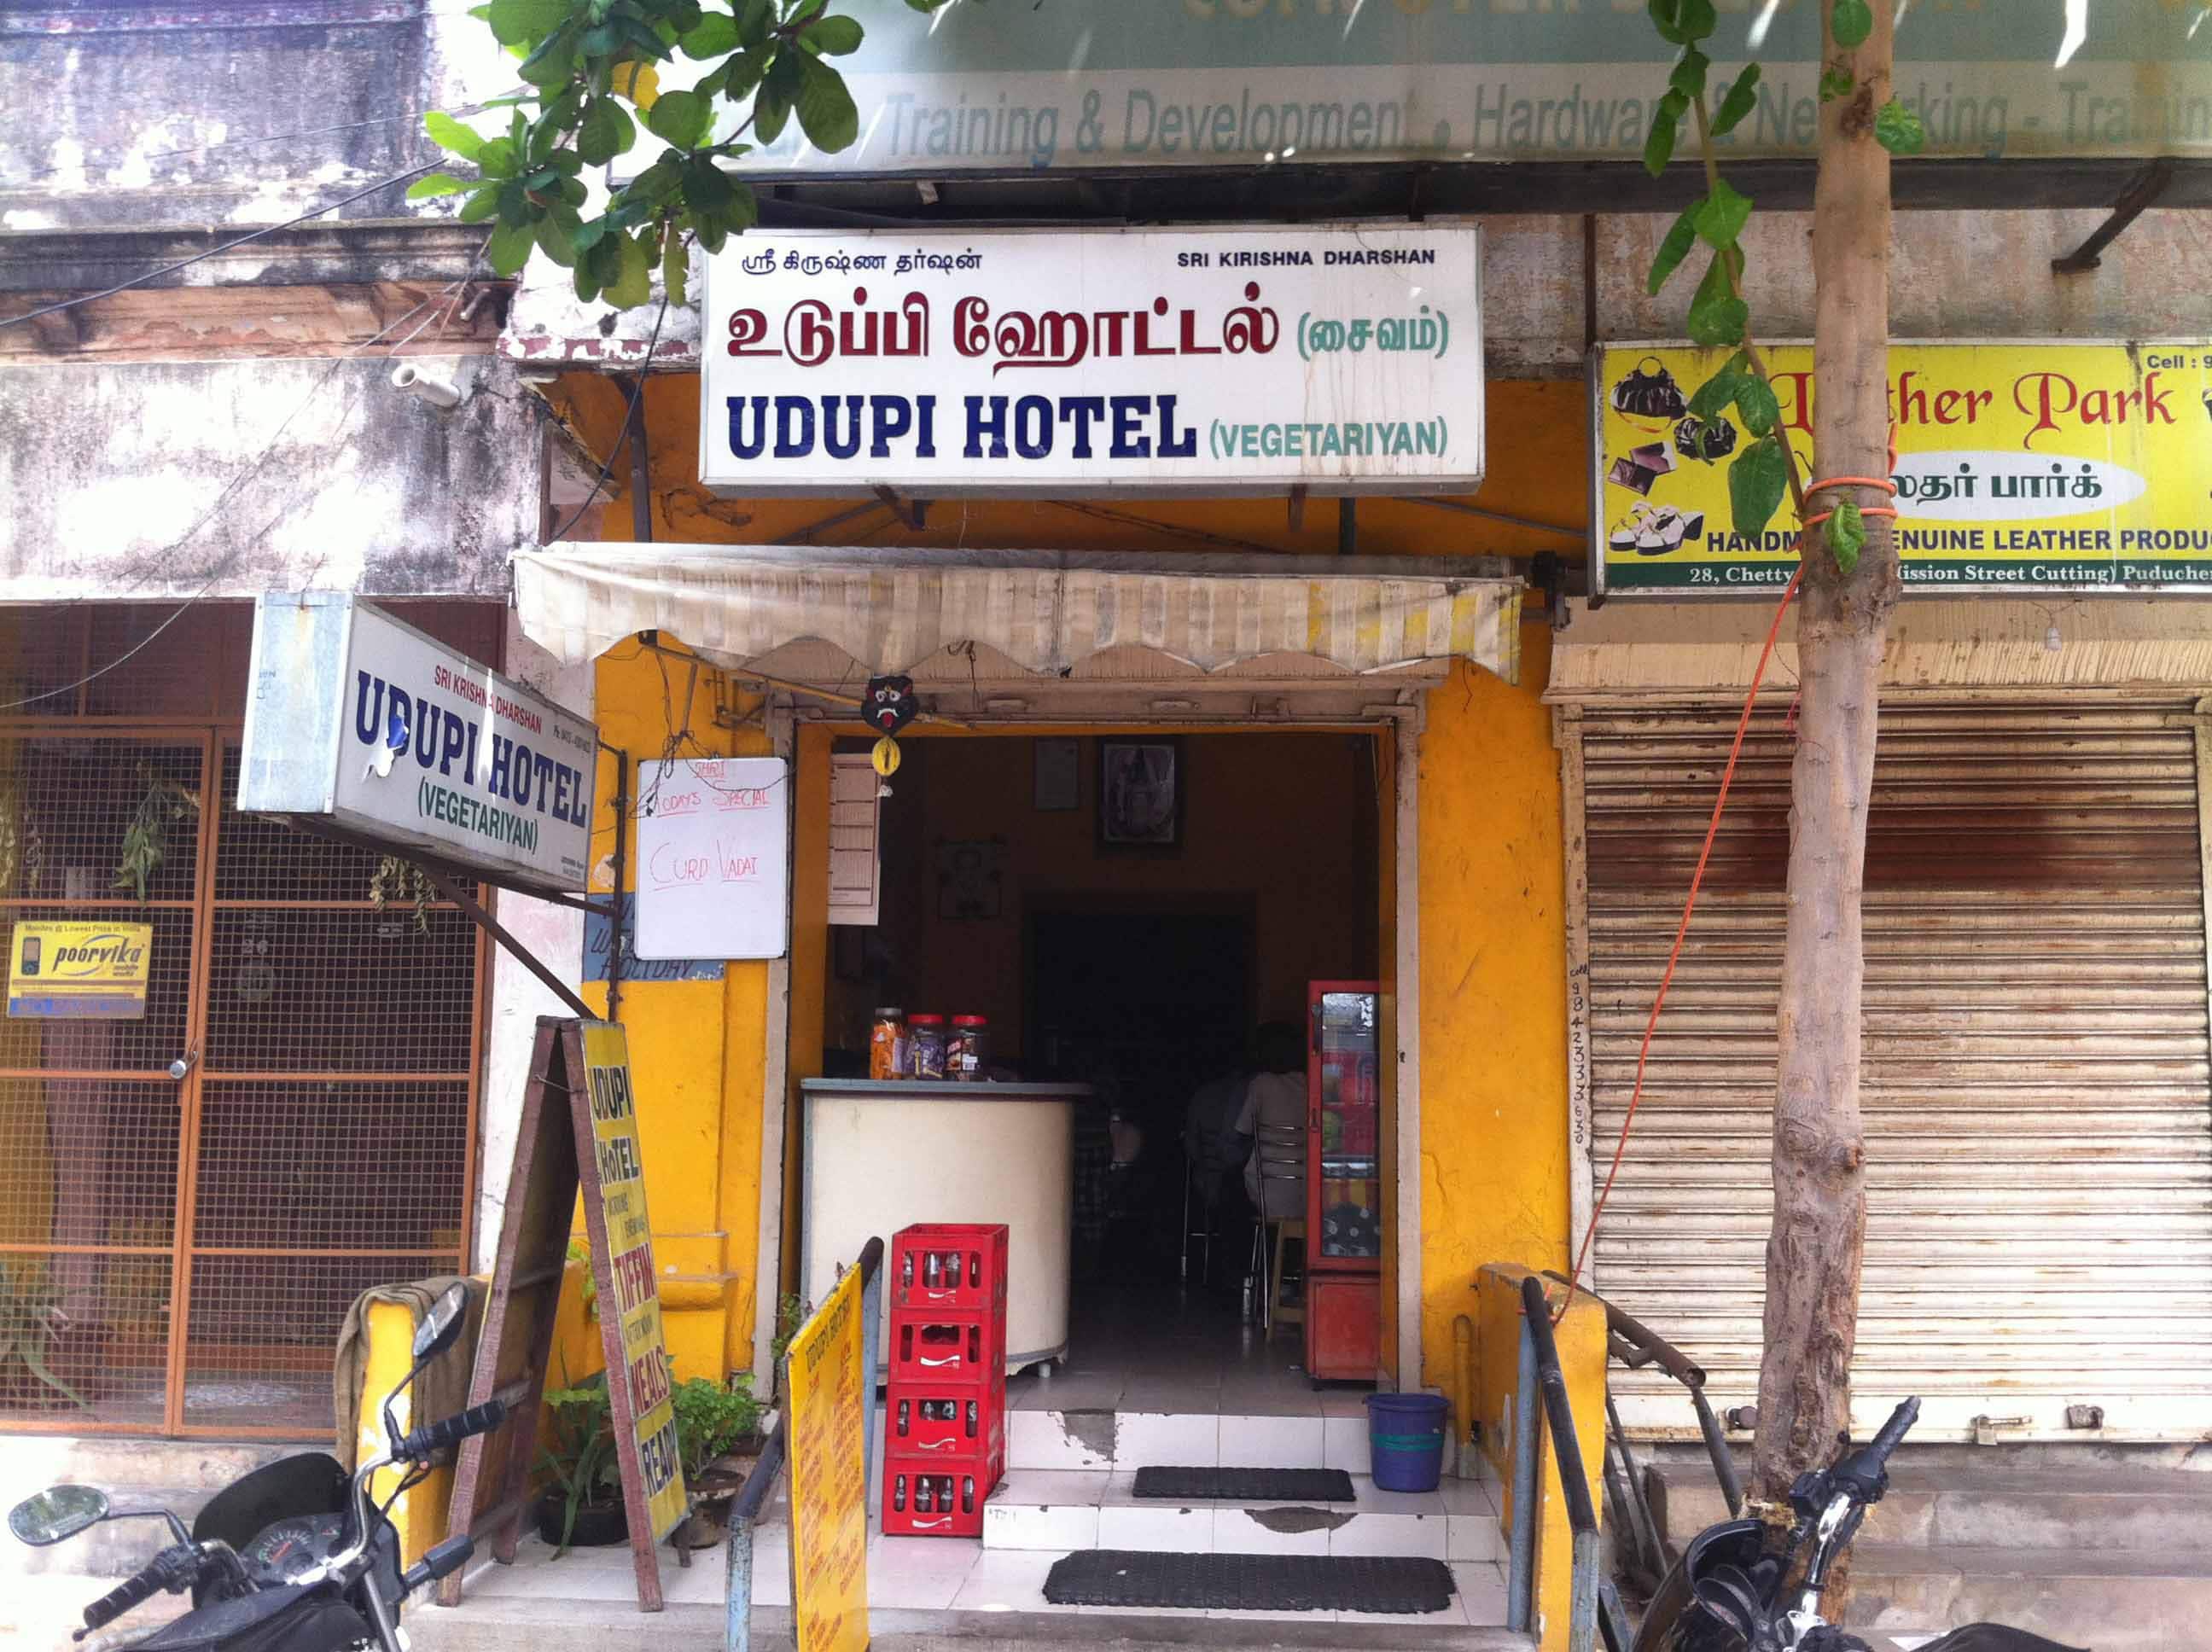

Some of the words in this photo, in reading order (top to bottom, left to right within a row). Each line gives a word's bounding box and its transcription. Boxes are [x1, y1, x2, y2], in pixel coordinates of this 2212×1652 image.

[886, 92, 1059, 168] Training
[1075, 90, 1104, 152] &
[783, 248, 887, 276] கிருஷ்ண
[894, 247, 983, 276] தர்ஷன்
[1177, 252, 1209, 267] SRI
[1220, 251, 1314, 267] KIRISHNA
[1324, 249, 1436, 265] DHARSHAN
[726, 286, 930, 368] உடுப்பி
[952, 281, 1280, 381] ஹோட்டல்
[2146, 354, 2185, 369] Cell
[725, 394, 937, 460] UDUPI
[963, 394, 1197, 460] HOTEL
[1209, 415, 1448, 461] (VEGETARIYAN)
[1768, 370, 1994, 438] Lher
[2012, 370, 2178, 451] Park
[1990, 462, 2103, 499] பார்க்
[1689, 568, 1720, 584] 28,
[1726, 567, 1796, 586] Chetty
[1897, 564, 1959, 581] ission
[1965, 565, 2026, 581] Street
[2030, 564, 2116, 584] Cutting)
[1707, 532, 1802, 553] HANDM
[1890, 529, 1984, 550] ENUINE
[1994, 529, 2113, 550] LEATHER
[2121, 529, 2212, 550] PRODU
[434, 665, 451, 690] SRI
[496, 695, 543, 736] DHARSHAN
[355, 669, 479, 786] UDUPI
[487, 733, 587, 829] HOTEL
[418, 776, 539, 856] (VEGETARIYAN)
[52, 936, 143, 972] poorvika
[588, 1066, 633, 1121] UDUPI
[614, 1242, 656, 1313] TIFFIN
[632, 1344, 669, 1416] MEALS
[641, 1417, 680, 1499] READY
